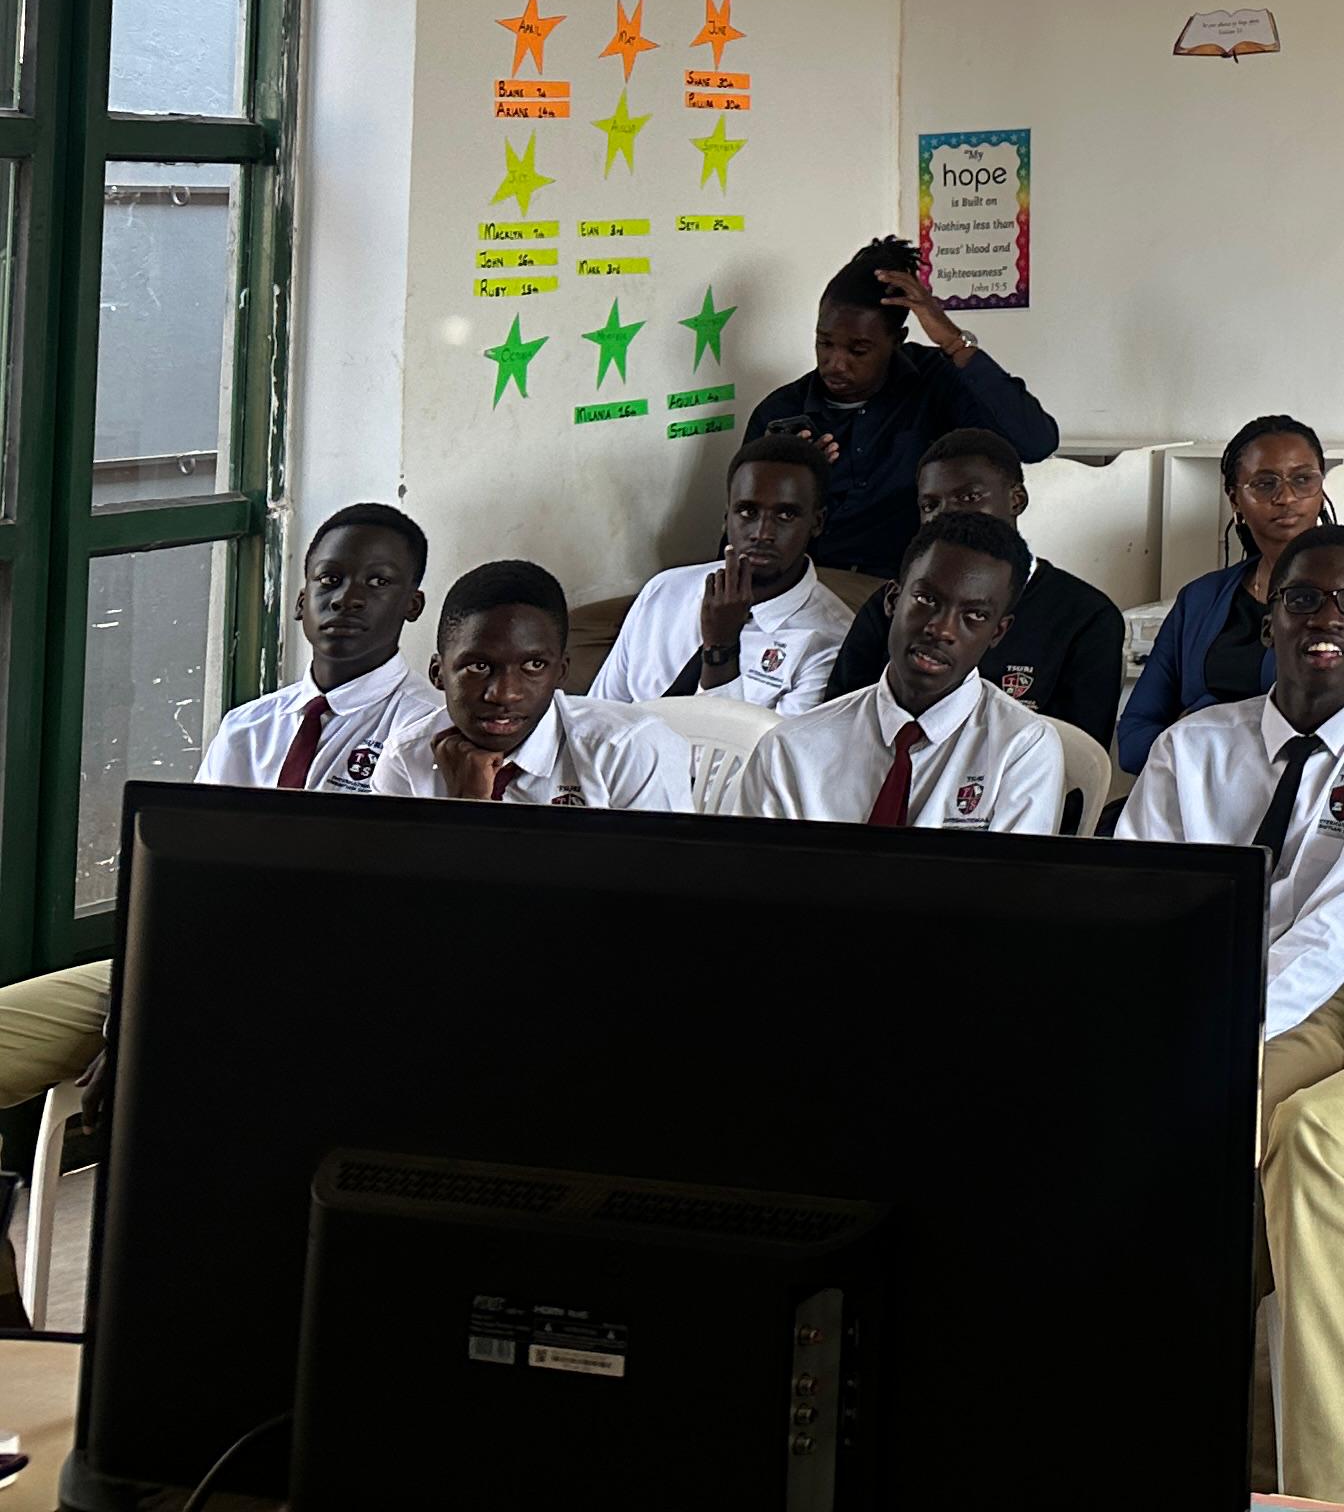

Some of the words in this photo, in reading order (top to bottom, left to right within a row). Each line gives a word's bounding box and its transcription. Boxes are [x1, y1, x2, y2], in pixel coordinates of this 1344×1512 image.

[943, 163, 1008, 192] hope
[951, 199, 959, 208] is
[962, 197, 983, 208] Built
[986, 197, 998, 207] on
[934, 221, 971, 233] Nothing
[973, 219, 991, 230] less
[993, 218, 1015, 230] than
[966, 243, 990, 254] blood
[993, 242, 1011, 253] and
